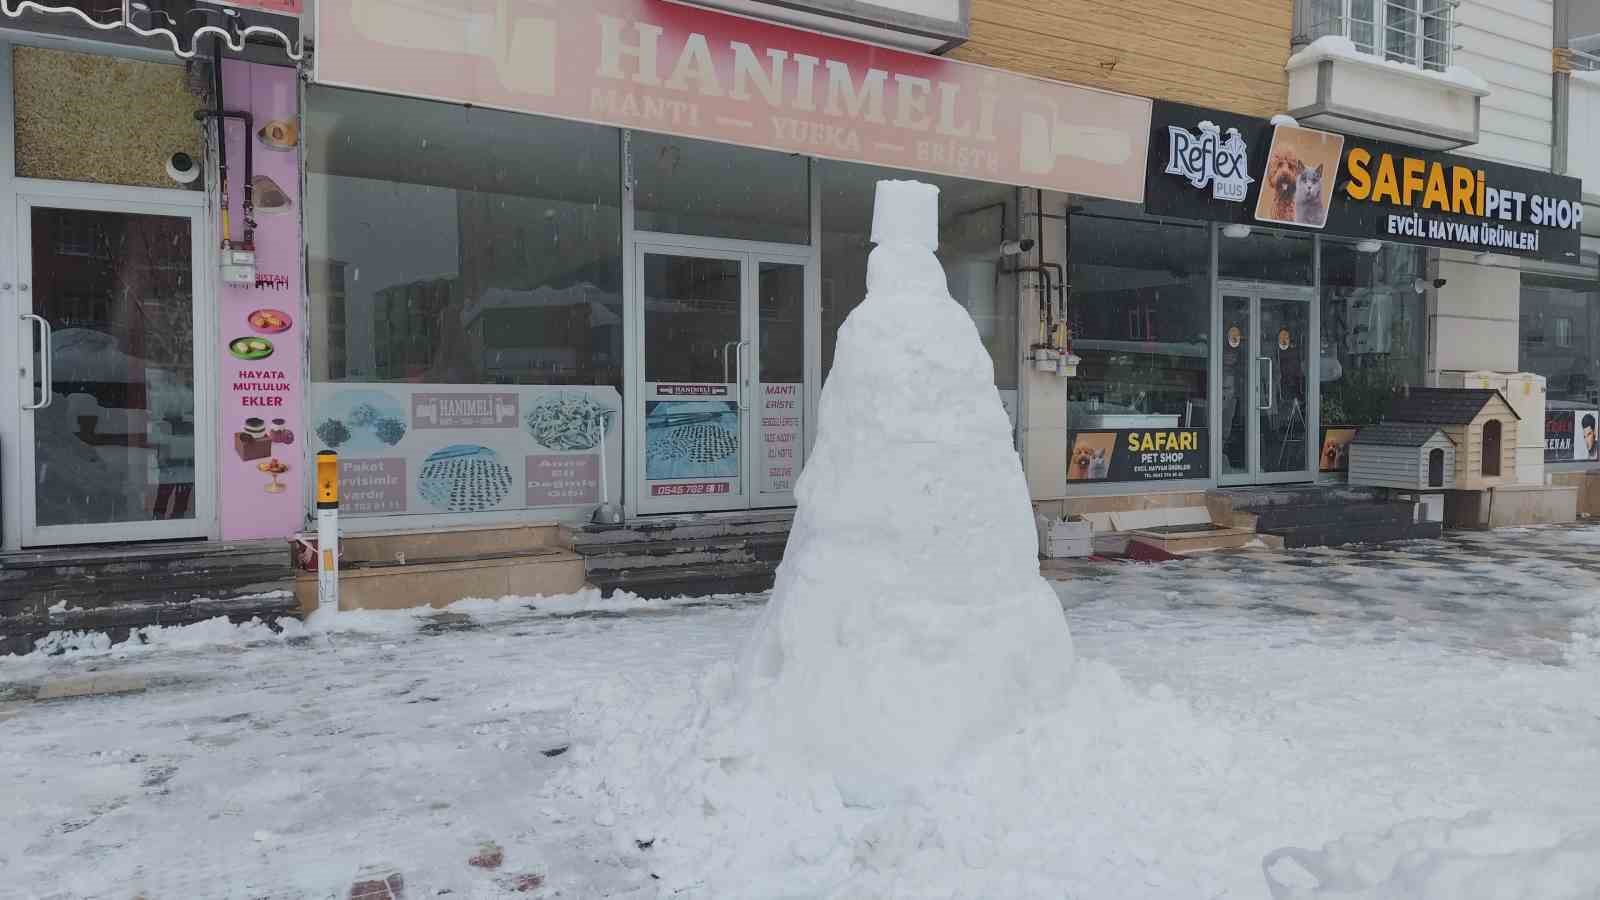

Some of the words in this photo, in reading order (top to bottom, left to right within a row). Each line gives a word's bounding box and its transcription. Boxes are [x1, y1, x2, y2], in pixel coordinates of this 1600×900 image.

[597, 13, 1001, 142] HANIMELİ
[591, 88, 699, 126] MANTI
[1173, 132, 1244, 183] Reflex
[1216, 182, 1243, 196] PLUS
[1346, 147, 1486, 217] SAFARİ
[1485, 187, 1526, 222] PET
[1529, 194, 1583, 230] SHOP
[1388, 212, 1425, 238] EVCİL
[1428, 221, 1479, 244] HAYVAN
[1480, 224, 1539, 251] ÜRÜNLERİ
[239, 370, 285, 379] HAYATA
[232, 382, 290, 391] MUTLULUK
[765, 385, 796, 396] MANTI
[242, 396, 283, 407] EKLER
[1141, 453, 1158, 463] PET
[1160, 452, 1184, 463] SHOP
[343, 461, 385, 473] Paket
